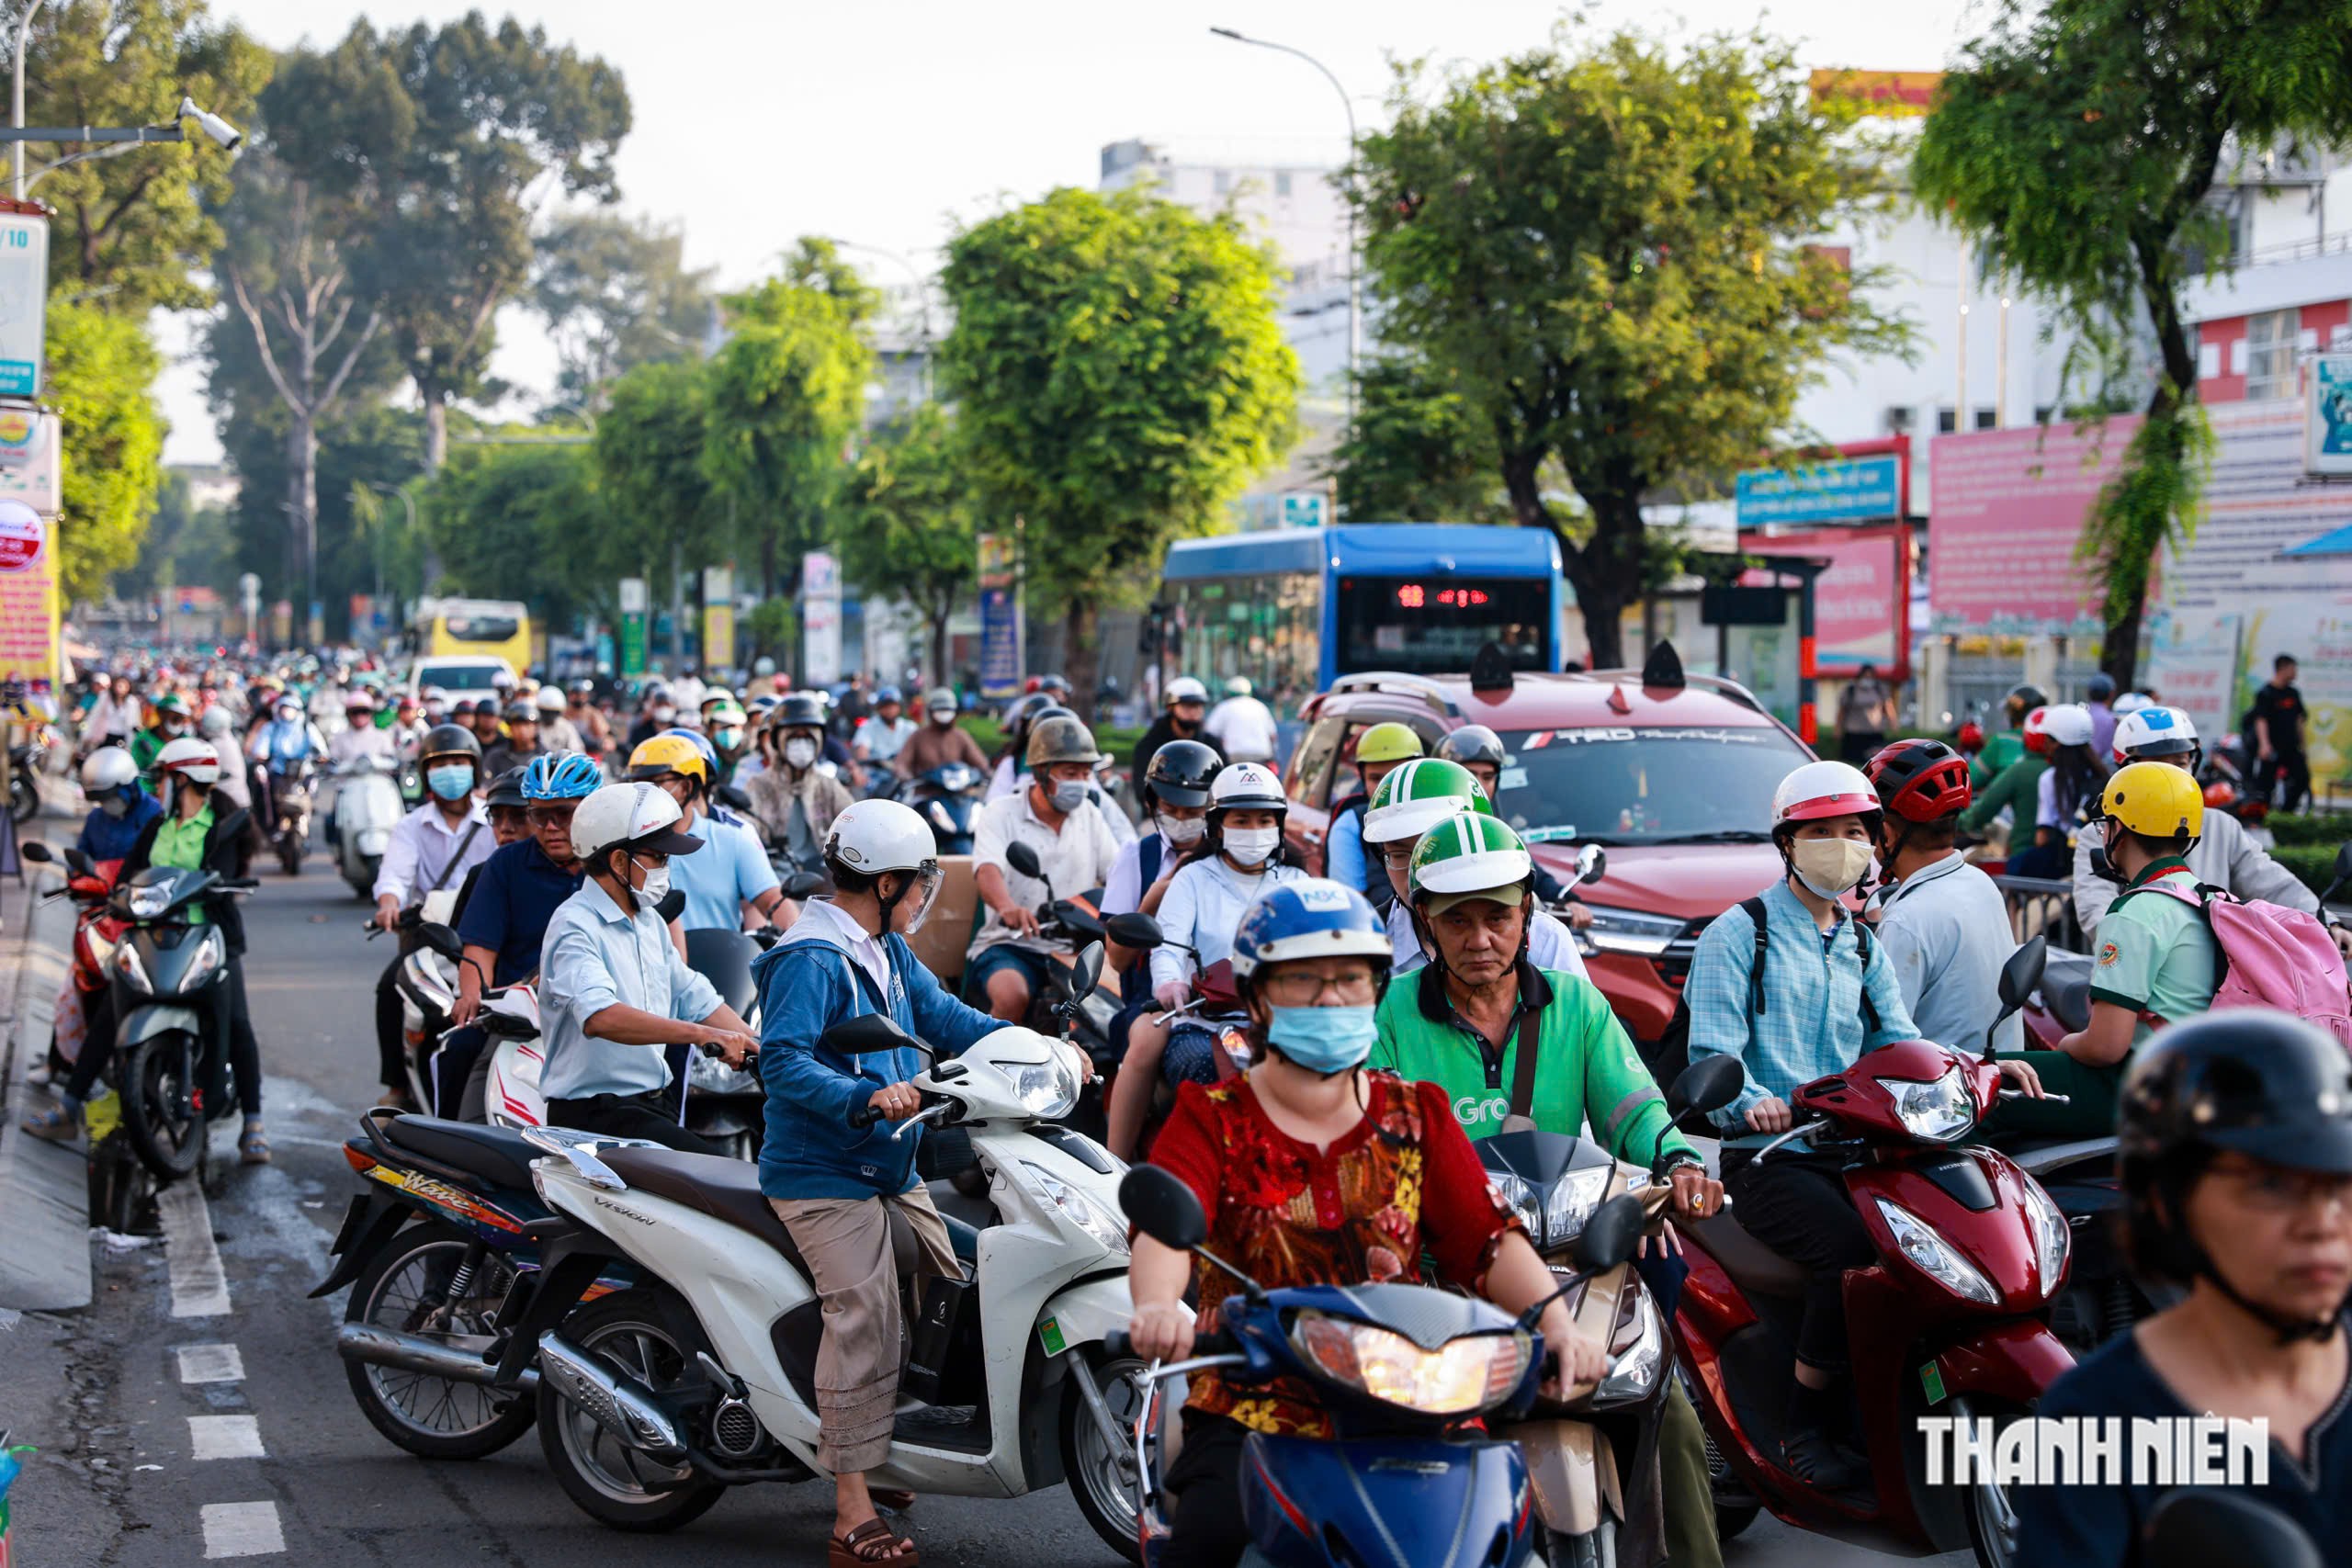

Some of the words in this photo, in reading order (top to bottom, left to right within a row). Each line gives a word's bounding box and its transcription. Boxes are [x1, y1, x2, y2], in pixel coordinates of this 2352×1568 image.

[1453, 1097, 1511, 1125] Gra
[400, 1169, 479, 1213] Wave
[594, 1197, 656, 1225] VISION
